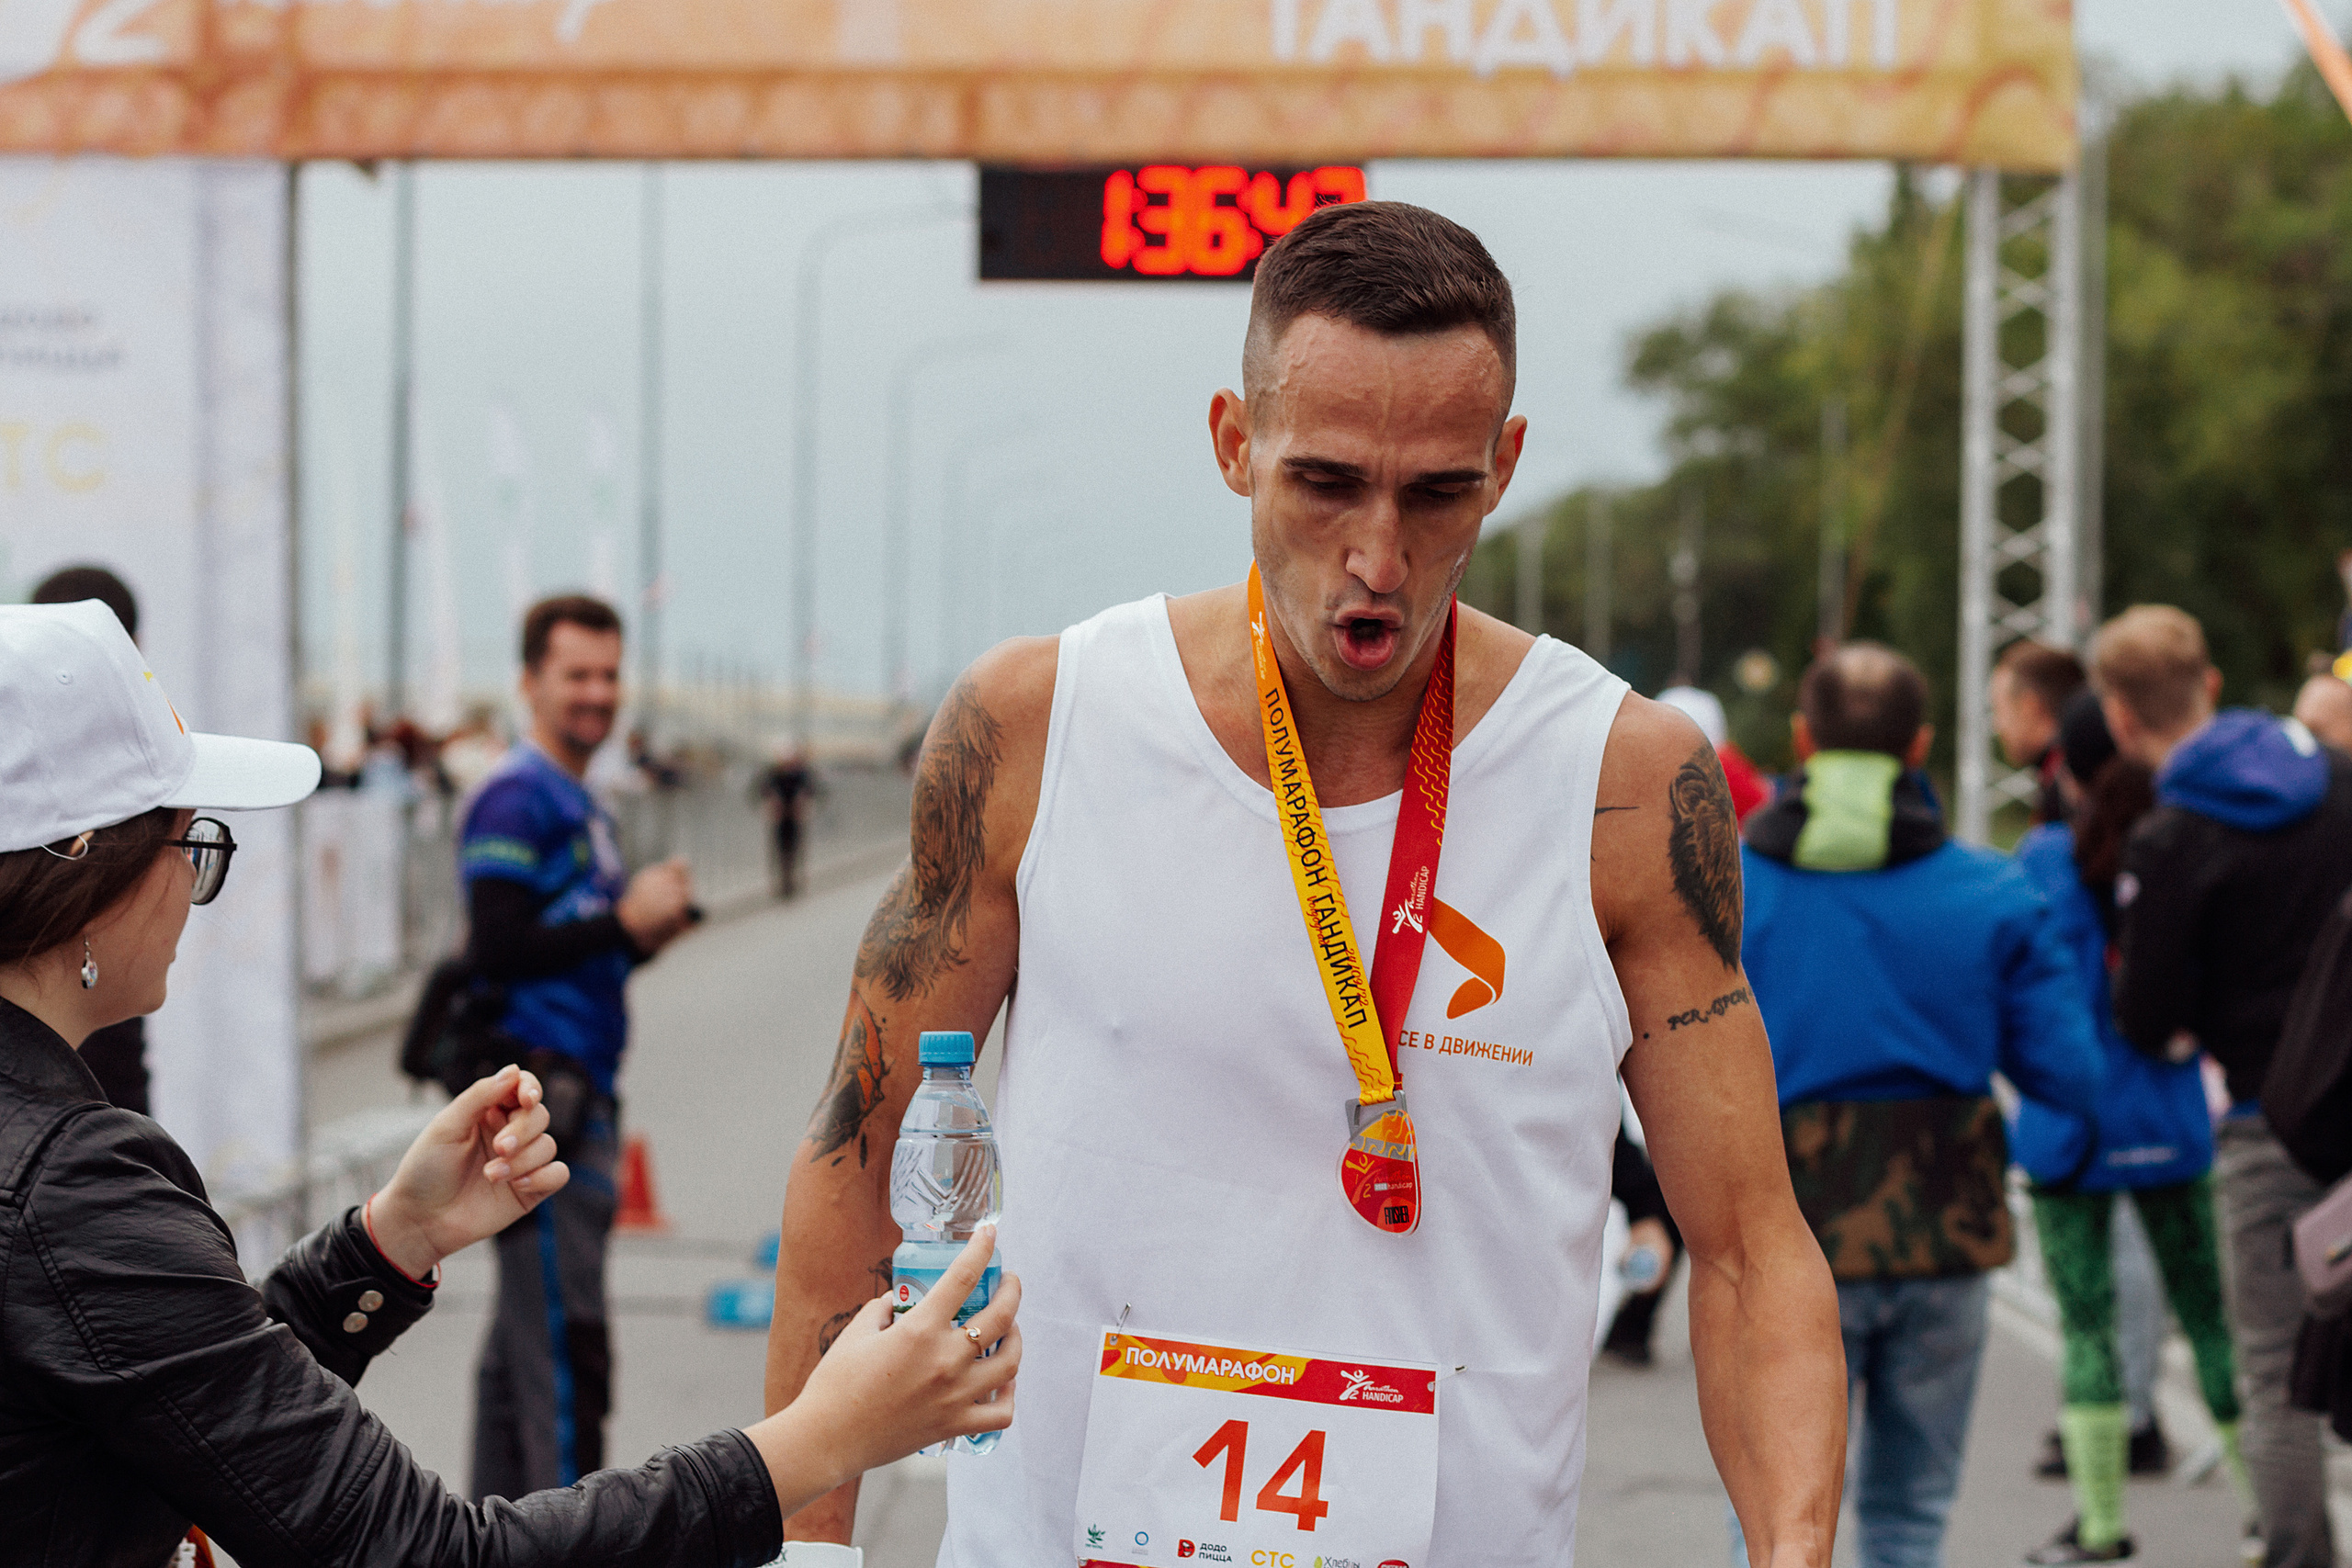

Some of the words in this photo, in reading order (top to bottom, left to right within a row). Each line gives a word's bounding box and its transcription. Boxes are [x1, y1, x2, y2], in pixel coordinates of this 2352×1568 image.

[1265, 687, 1329, 887] ПОЛУМАРАФОН
[1312, 893, 1368, 1029] ГАНДИКАП
[1415, 865, 1430, 909] HANDICAP
[1423, 1033, 1435, 1050] В
[1438, 1035, 1534, 1066] ДВИЖЕНИИ
[1125, 1347, 1295, 1385] ПОЛУМАРАФОН
[1362, 1391, 1405, 1404] HANDICAP
[1192, 1419, 1329, 1531] 14
[1198, 1551, 1232, 1562] ПИЦЦА
[1199, 1542, 1227, 1552] ДОДО
[1250, 1550, 1295, 1568] СТС
